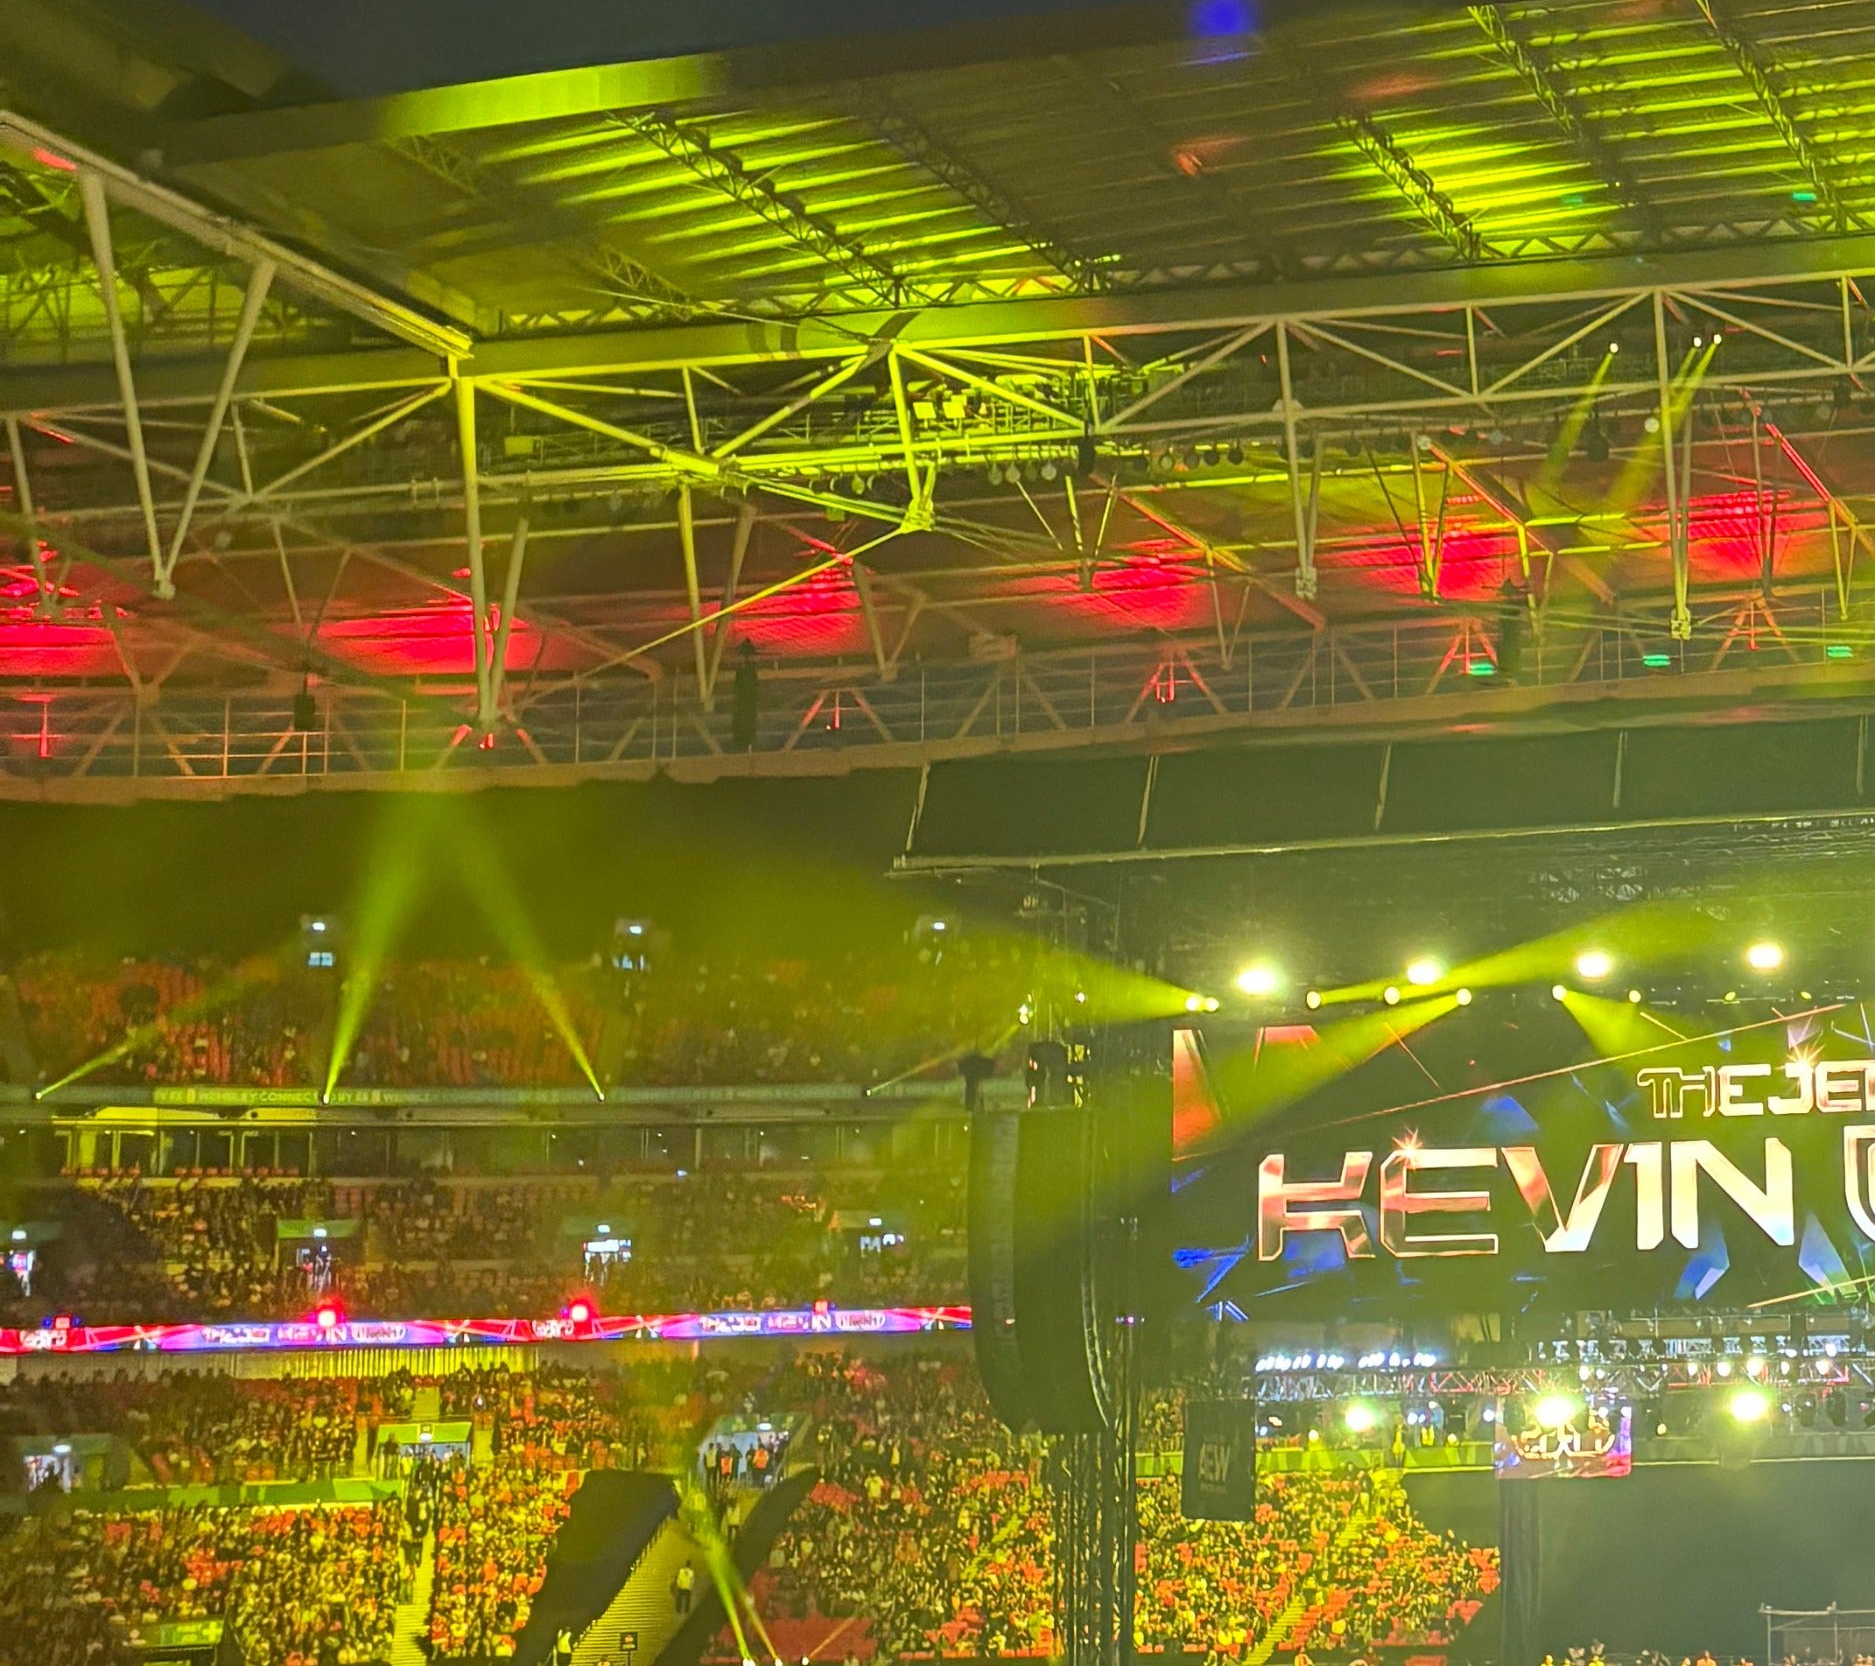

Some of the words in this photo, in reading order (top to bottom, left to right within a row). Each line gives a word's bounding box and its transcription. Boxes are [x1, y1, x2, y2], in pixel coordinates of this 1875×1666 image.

[260, 1091, 336, 1103] CONNECTD
[1638, 1063, 1771, 1119] THE
[1258, 1136, 1795, 1261] KEVIN
